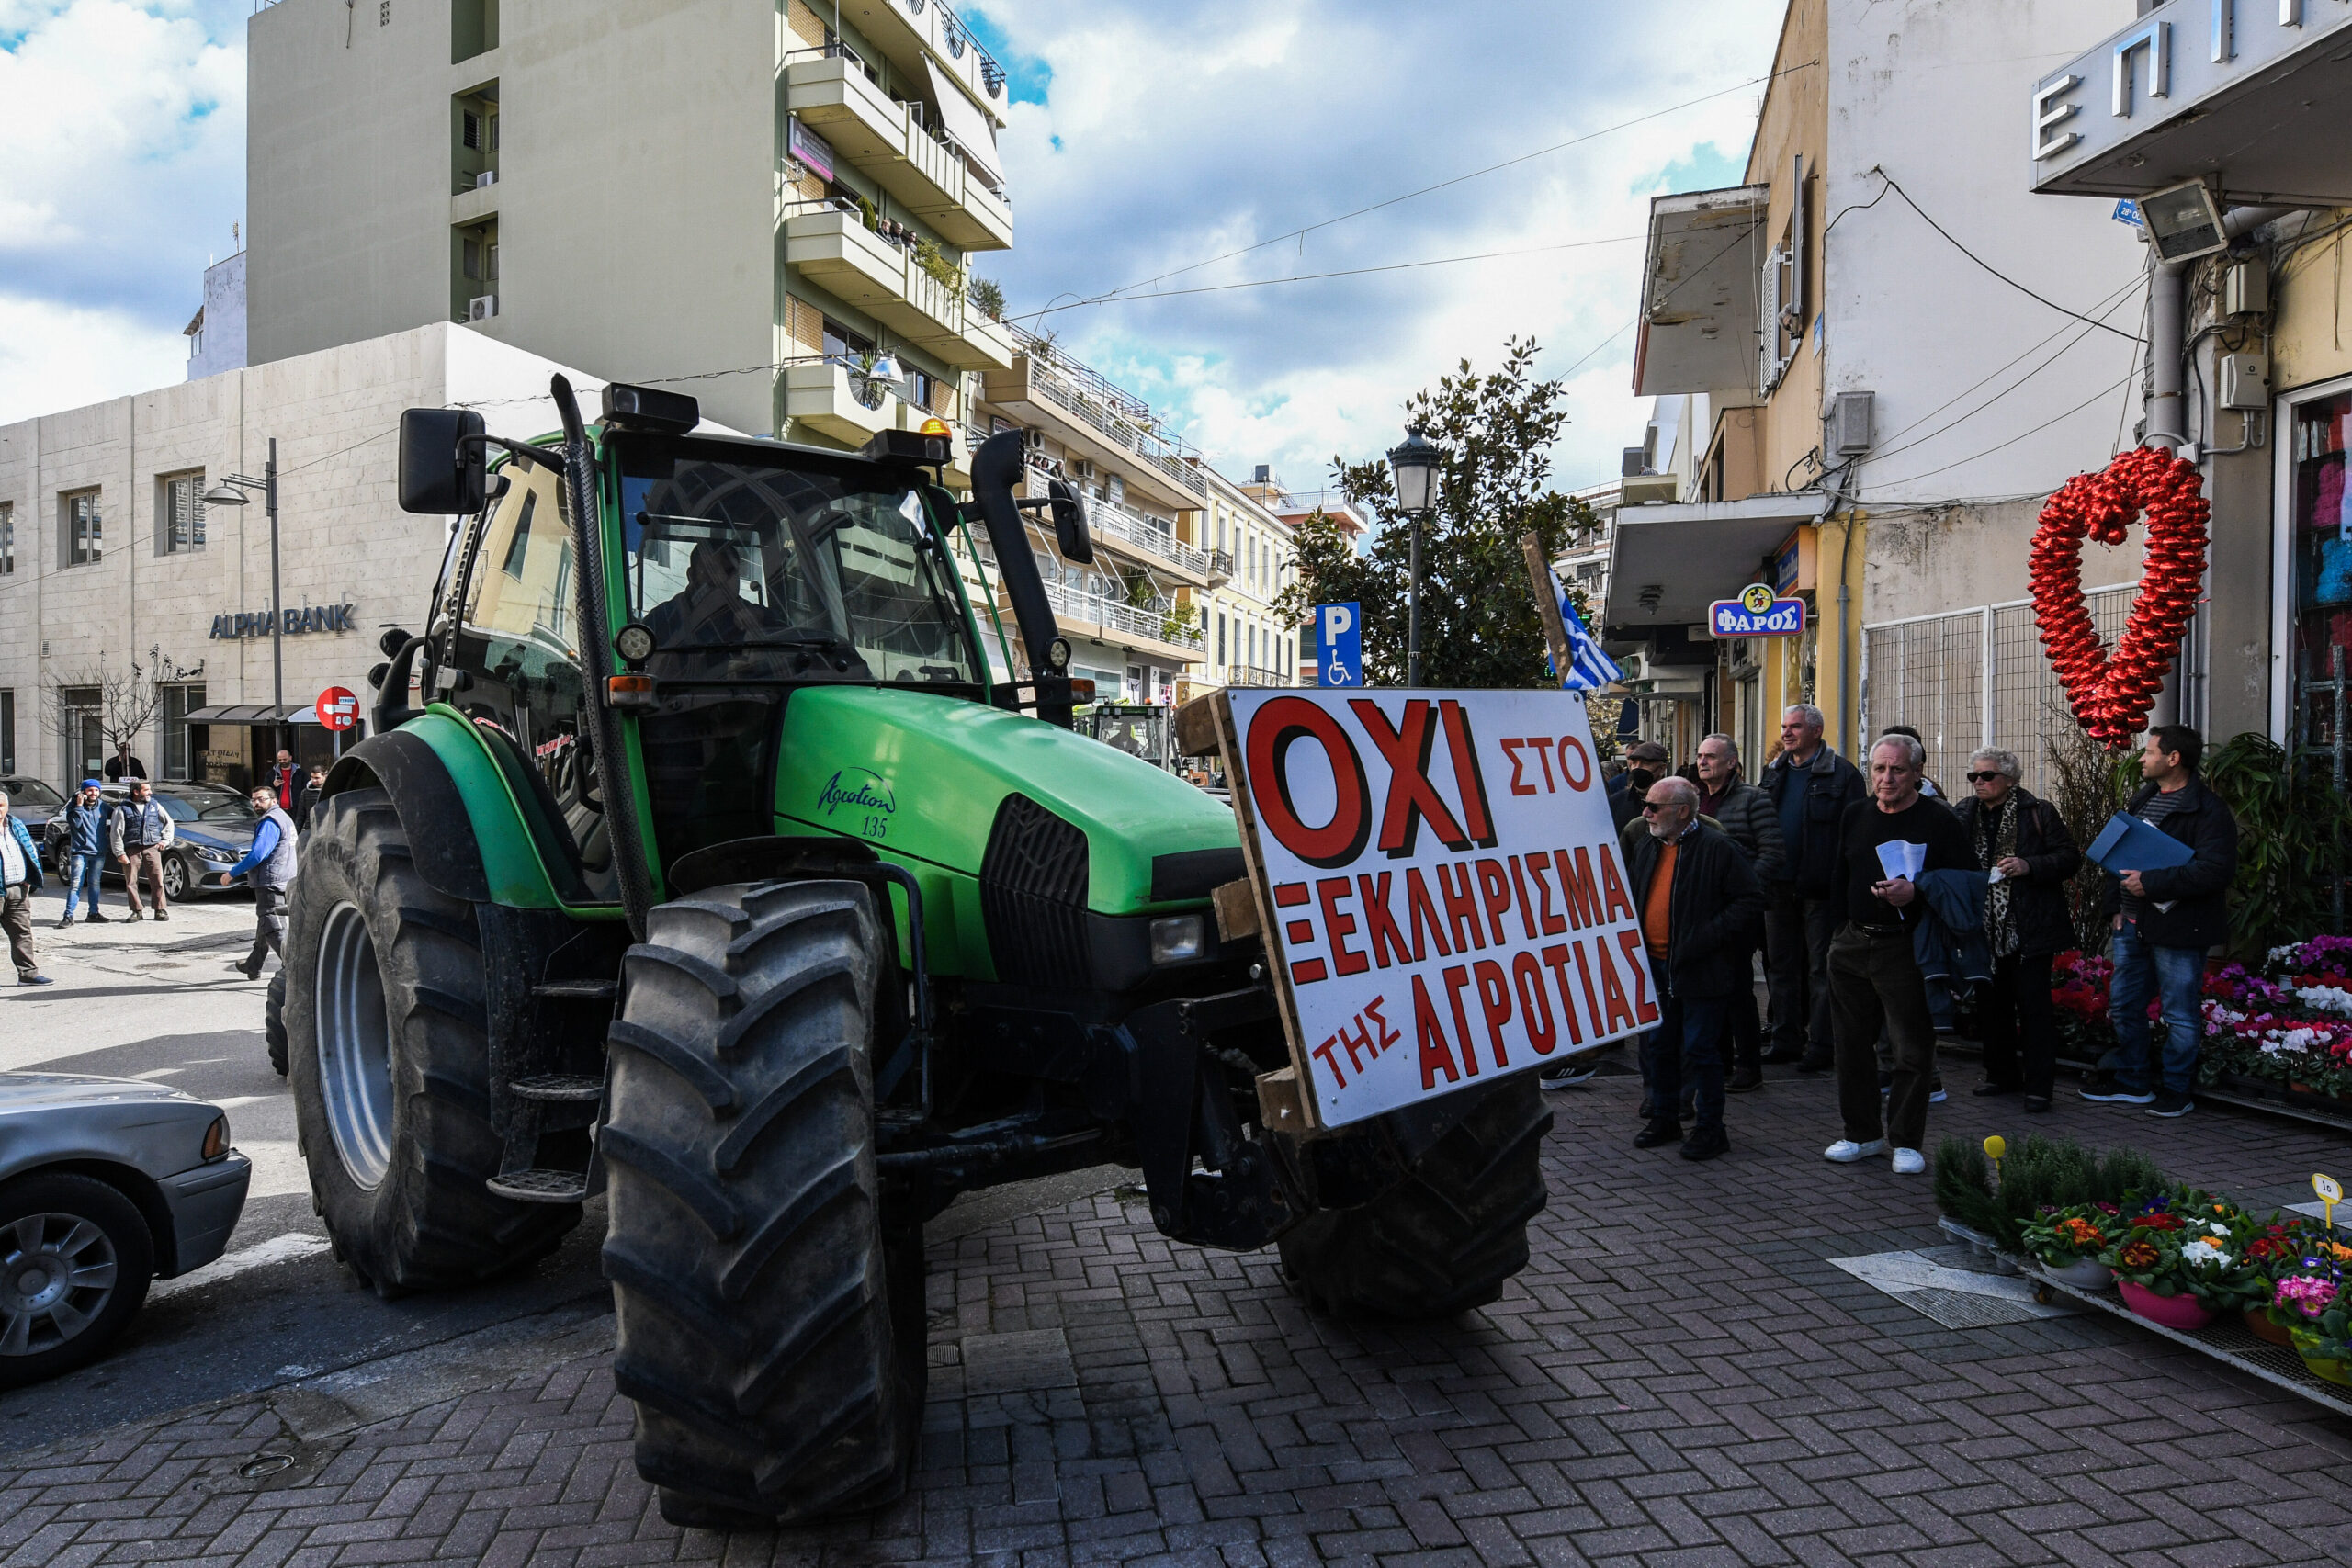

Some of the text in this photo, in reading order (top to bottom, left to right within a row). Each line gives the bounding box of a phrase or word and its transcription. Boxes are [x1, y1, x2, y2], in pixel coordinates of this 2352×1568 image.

[209, 603, 356, 640] ALPHA BANK
[1325, 606, 1351, 646] P
[1717, 605, 1797, 632] ΦΑΡΟΣ
[1246, 695, 1591, 869] ΟΧΙ ΣΤΟ
[861, 816, 888, 838] 135
[1273, 843, 1634, 986] ΞΕΚΛΗΡΙΣΜΑ
[1312, 929, 1659, 1090] ΤΗΣ ΑΓΡΟΤΙΑΣ
